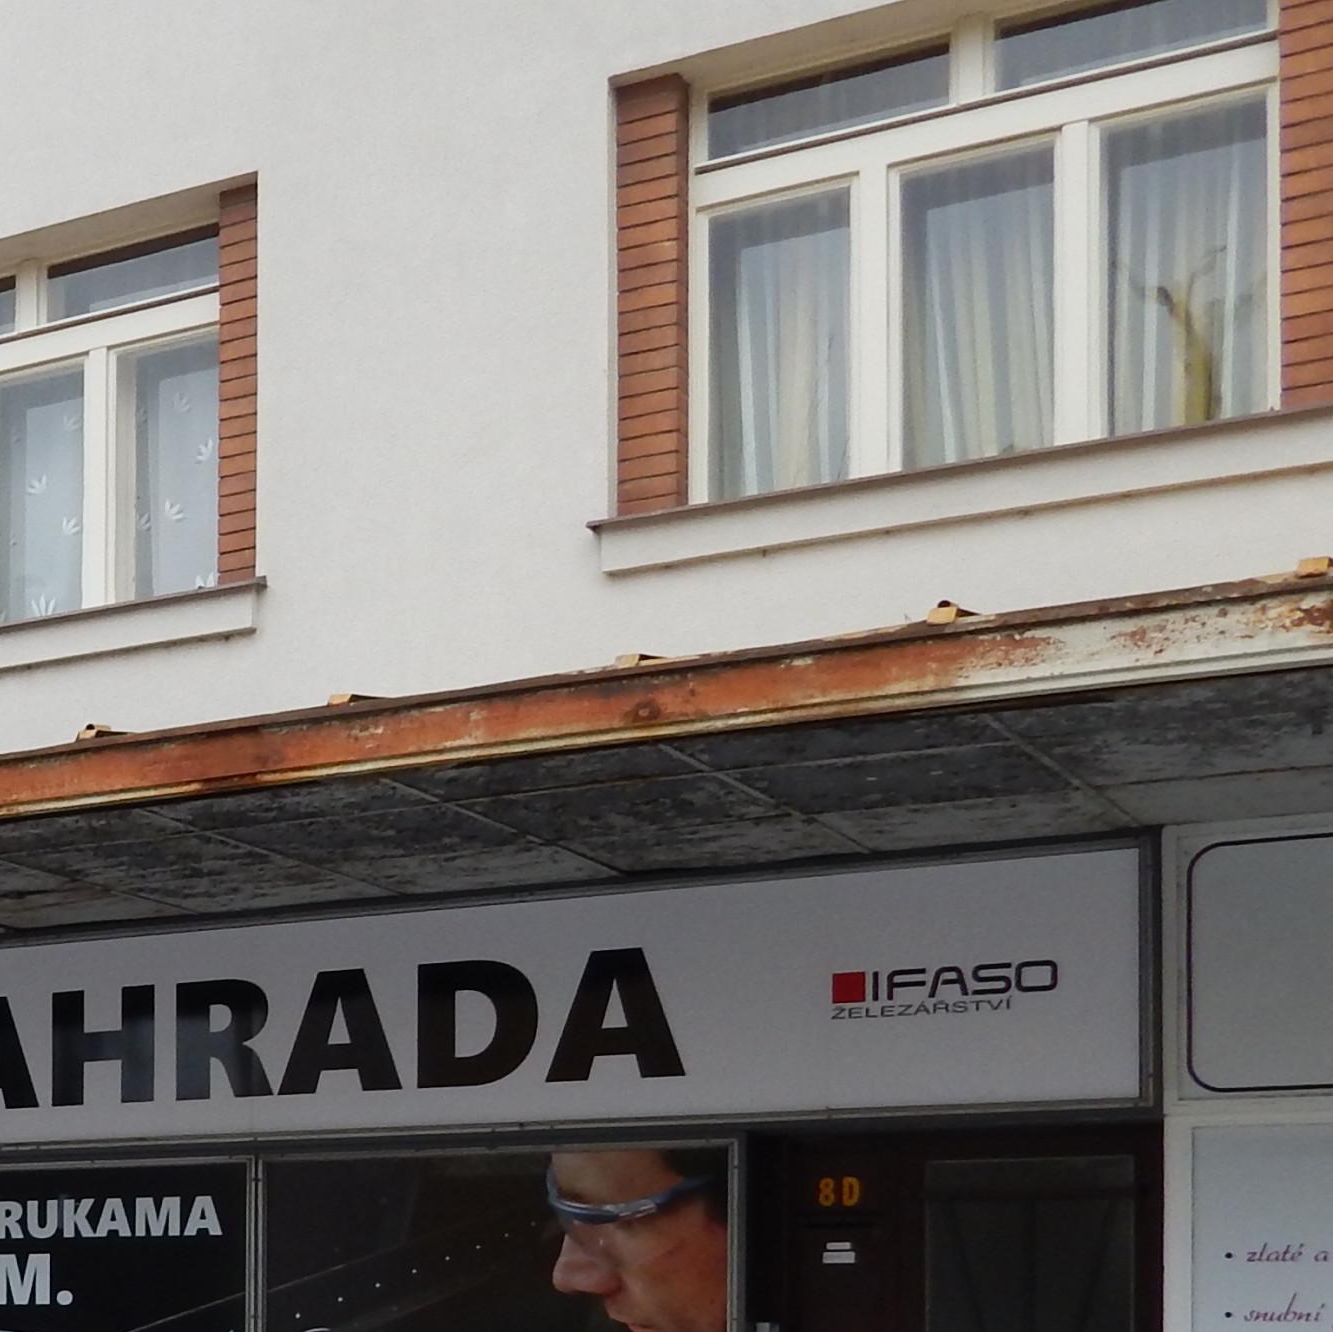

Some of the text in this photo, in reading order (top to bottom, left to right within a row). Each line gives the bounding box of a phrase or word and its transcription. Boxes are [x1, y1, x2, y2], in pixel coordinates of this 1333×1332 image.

[872, 960, 1058, 1001] IFASO
[831, 996, 1012, 1020] ŽELEZÁŘSTVÍ
[1246, 1243, 1304, 1263] zlaté
[1244, 1292, 1326, 1322] snubní
